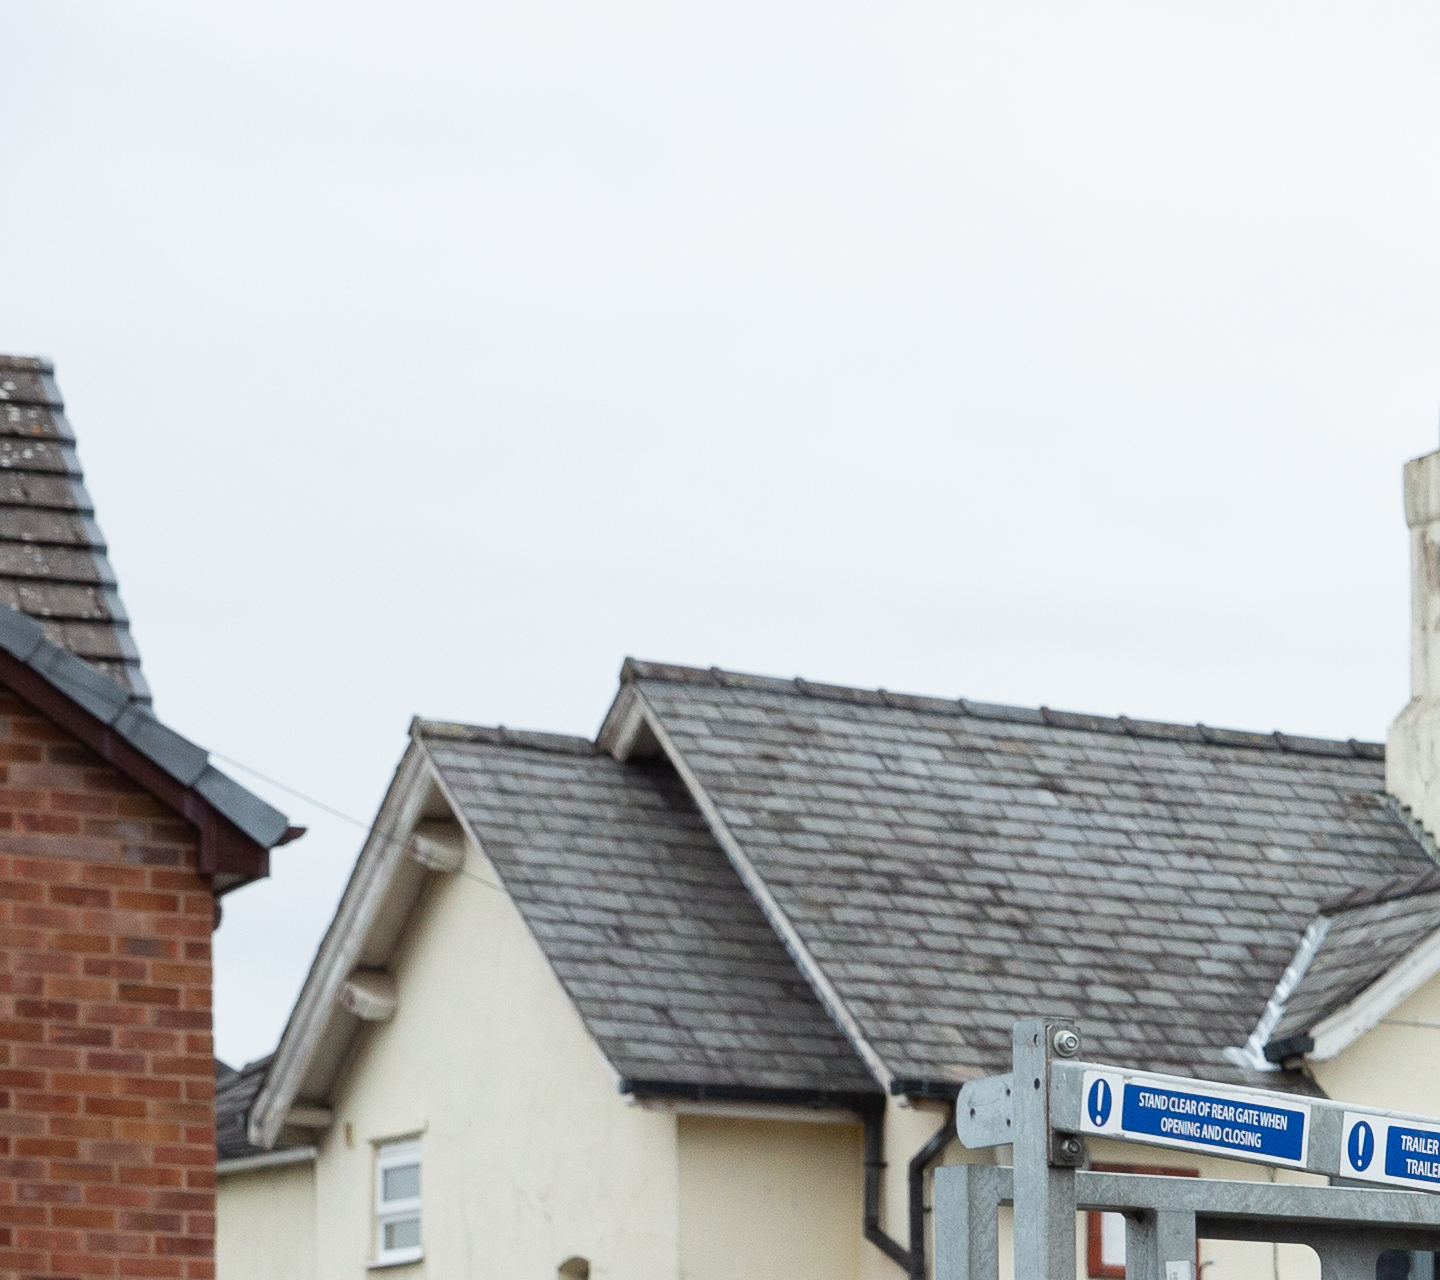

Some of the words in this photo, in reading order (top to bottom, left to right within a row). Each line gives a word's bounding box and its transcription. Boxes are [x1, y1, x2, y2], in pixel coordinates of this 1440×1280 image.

[1139, 1092, 1168, 1110] STAND
[1169, 1097, 1196, 1115] CLEAR
[1198, 1102, 1210, 1117] OF
[1212, 1104, 1234, 1121] REAR
[1236, 1108, 1258, 1125] GATE
[1260, 1112, 1288, 1130] WHEN
[1161, 1117, 1200, 1138] OPENING
[1201, 1124, 1221, 1141] AND
[1223, 1127, 1261, 1148] CLOSING
[1401, 1135, 1438, 1155] TRAILER
